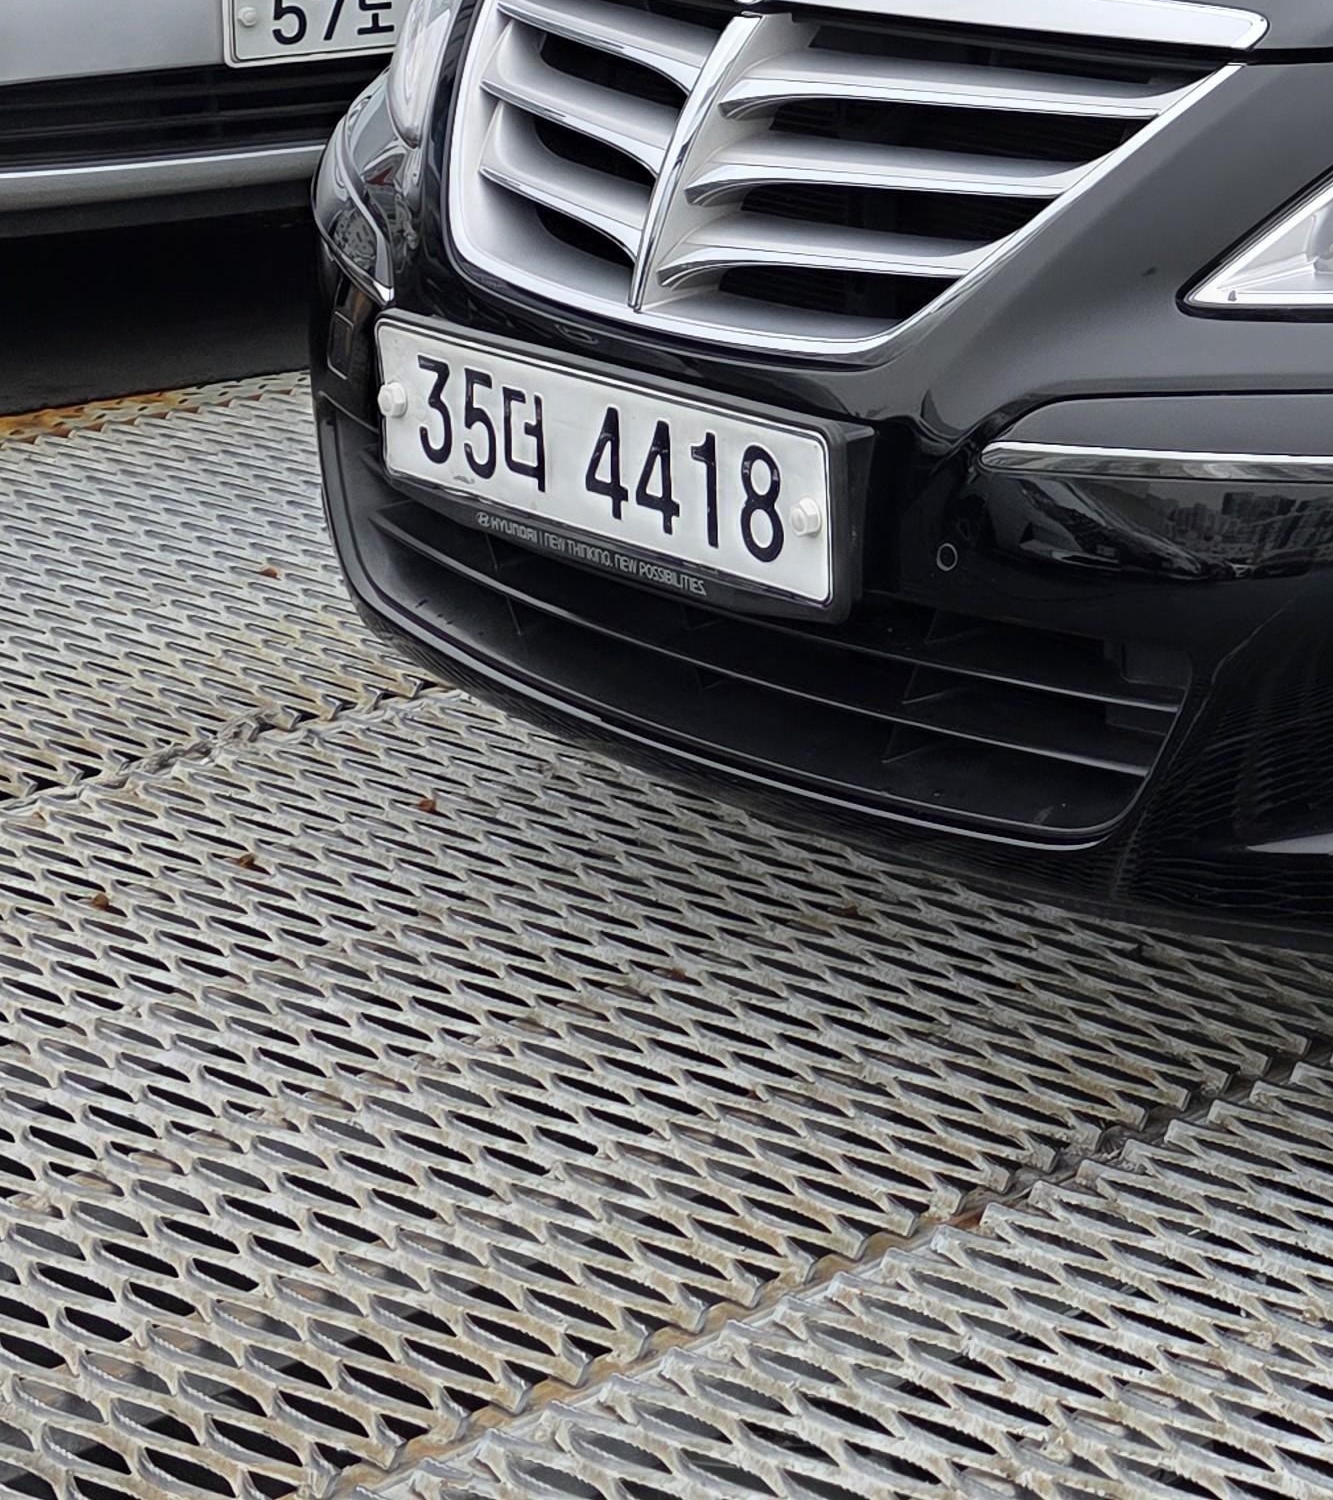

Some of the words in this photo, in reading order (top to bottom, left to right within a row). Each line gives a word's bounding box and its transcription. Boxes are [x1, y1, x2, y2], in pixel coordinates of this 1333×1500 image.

[417, 353, 546, 493] 35더
[585, 406, 785, 564] 4418
[491, 515, 538, 544] HYUNDAI
[543, 532, 567, 552] NEW
[614, 554, 638, 574] NEW
